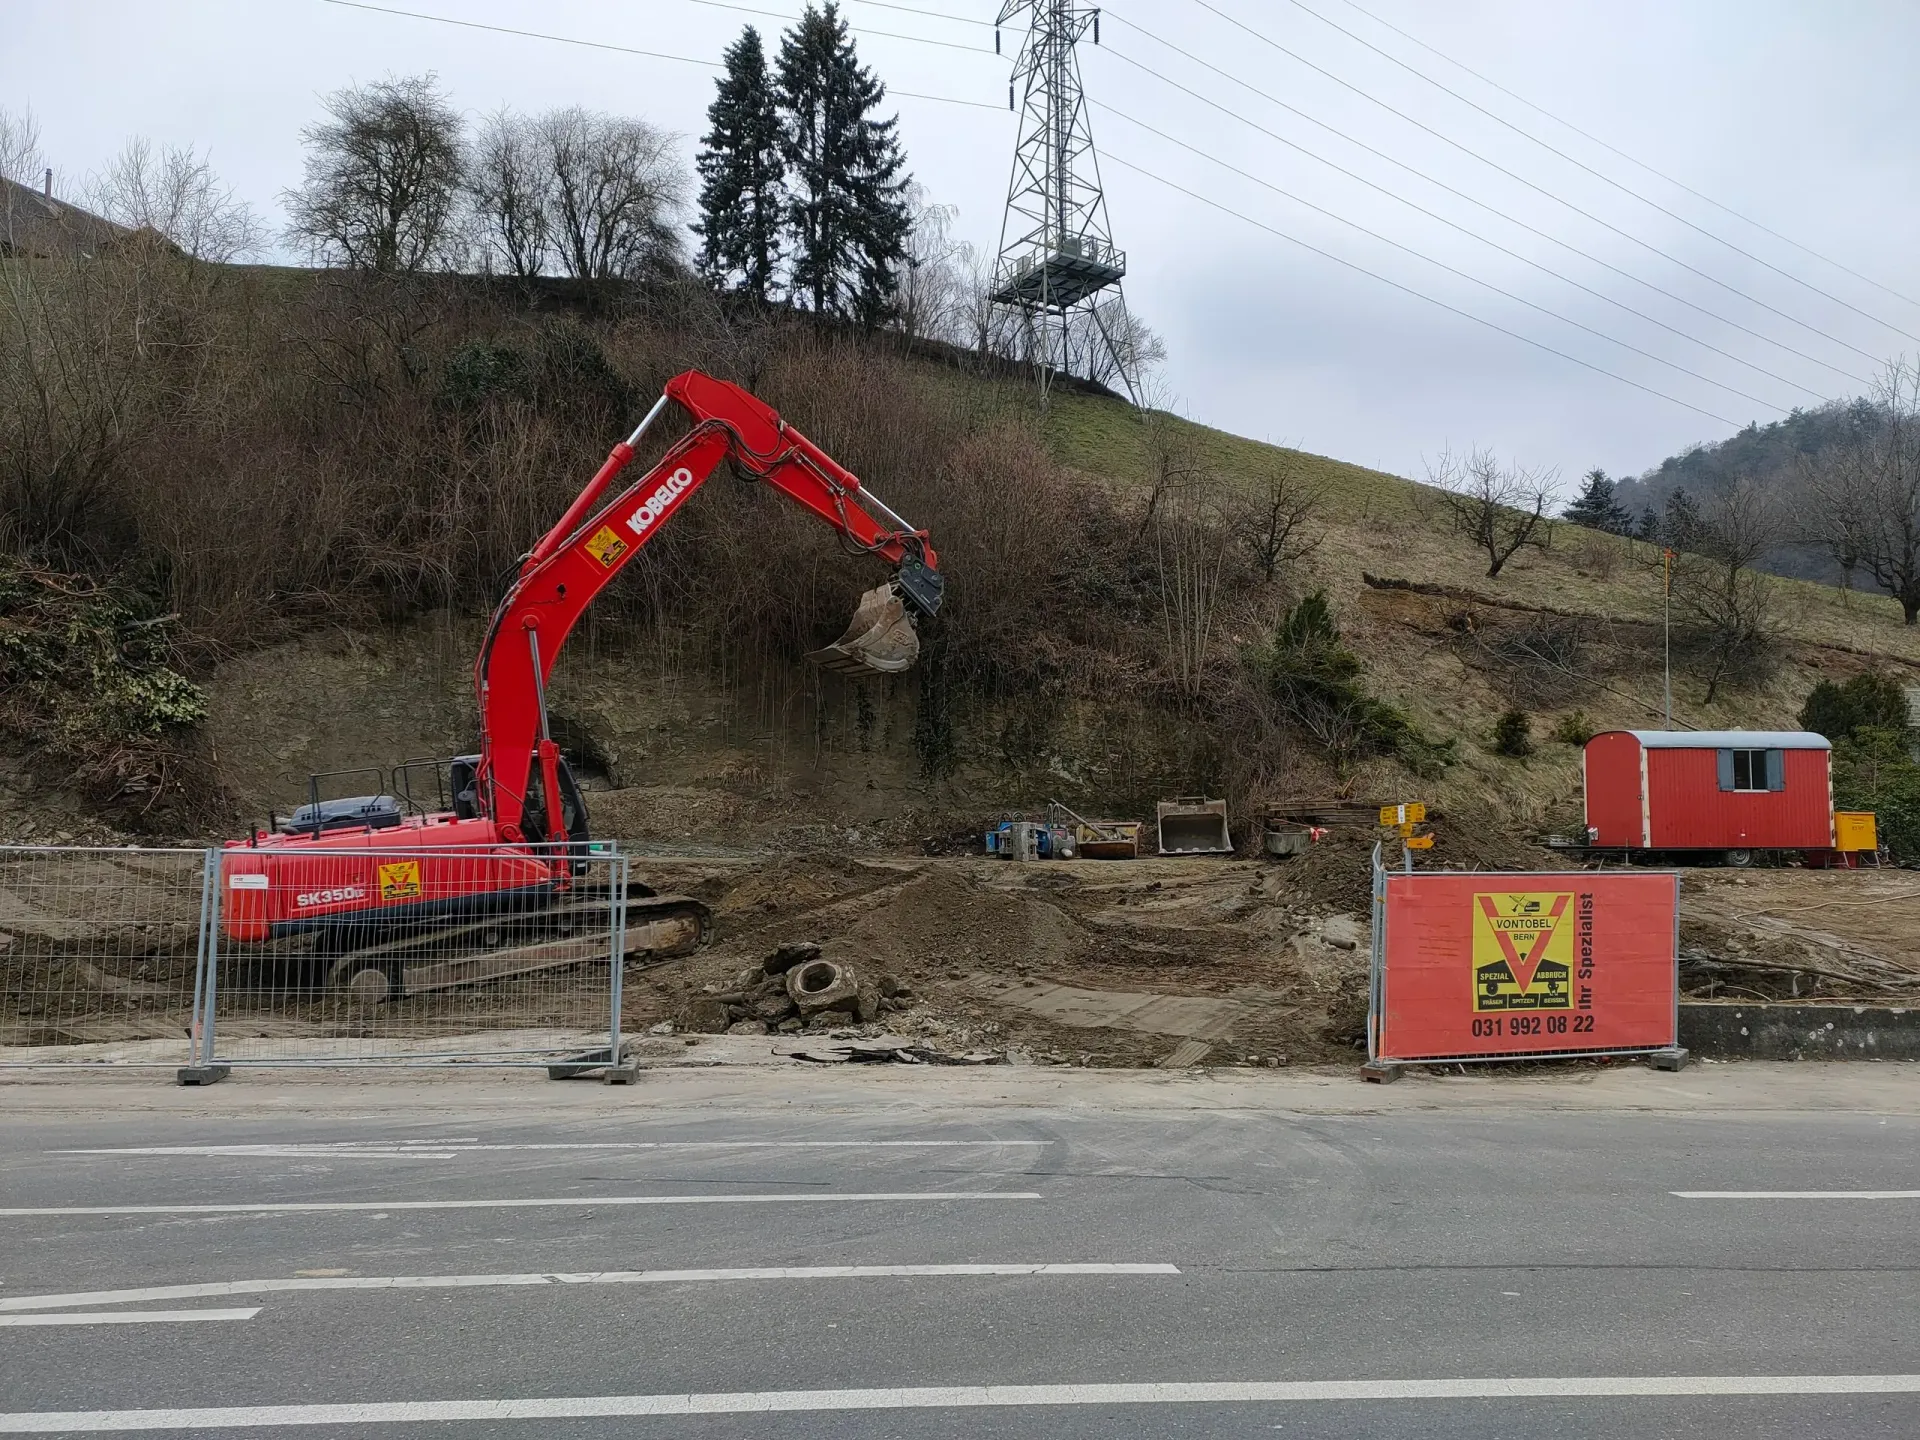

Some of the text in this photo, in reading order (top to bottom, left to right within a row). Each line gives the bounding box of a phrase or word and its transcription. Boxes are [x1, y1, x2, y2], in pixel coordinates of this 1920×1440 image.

[626, 467, 693, 535] KOBELCO
[1496, 919, 1551, 929] VONTOBEL
[1578, 893, 1595, 1009] Ihr Spezialist
[1536, 971, 1567, 979] ABBRUCH
[1471, 1015, 1595, 1037] 031 992 08 22
